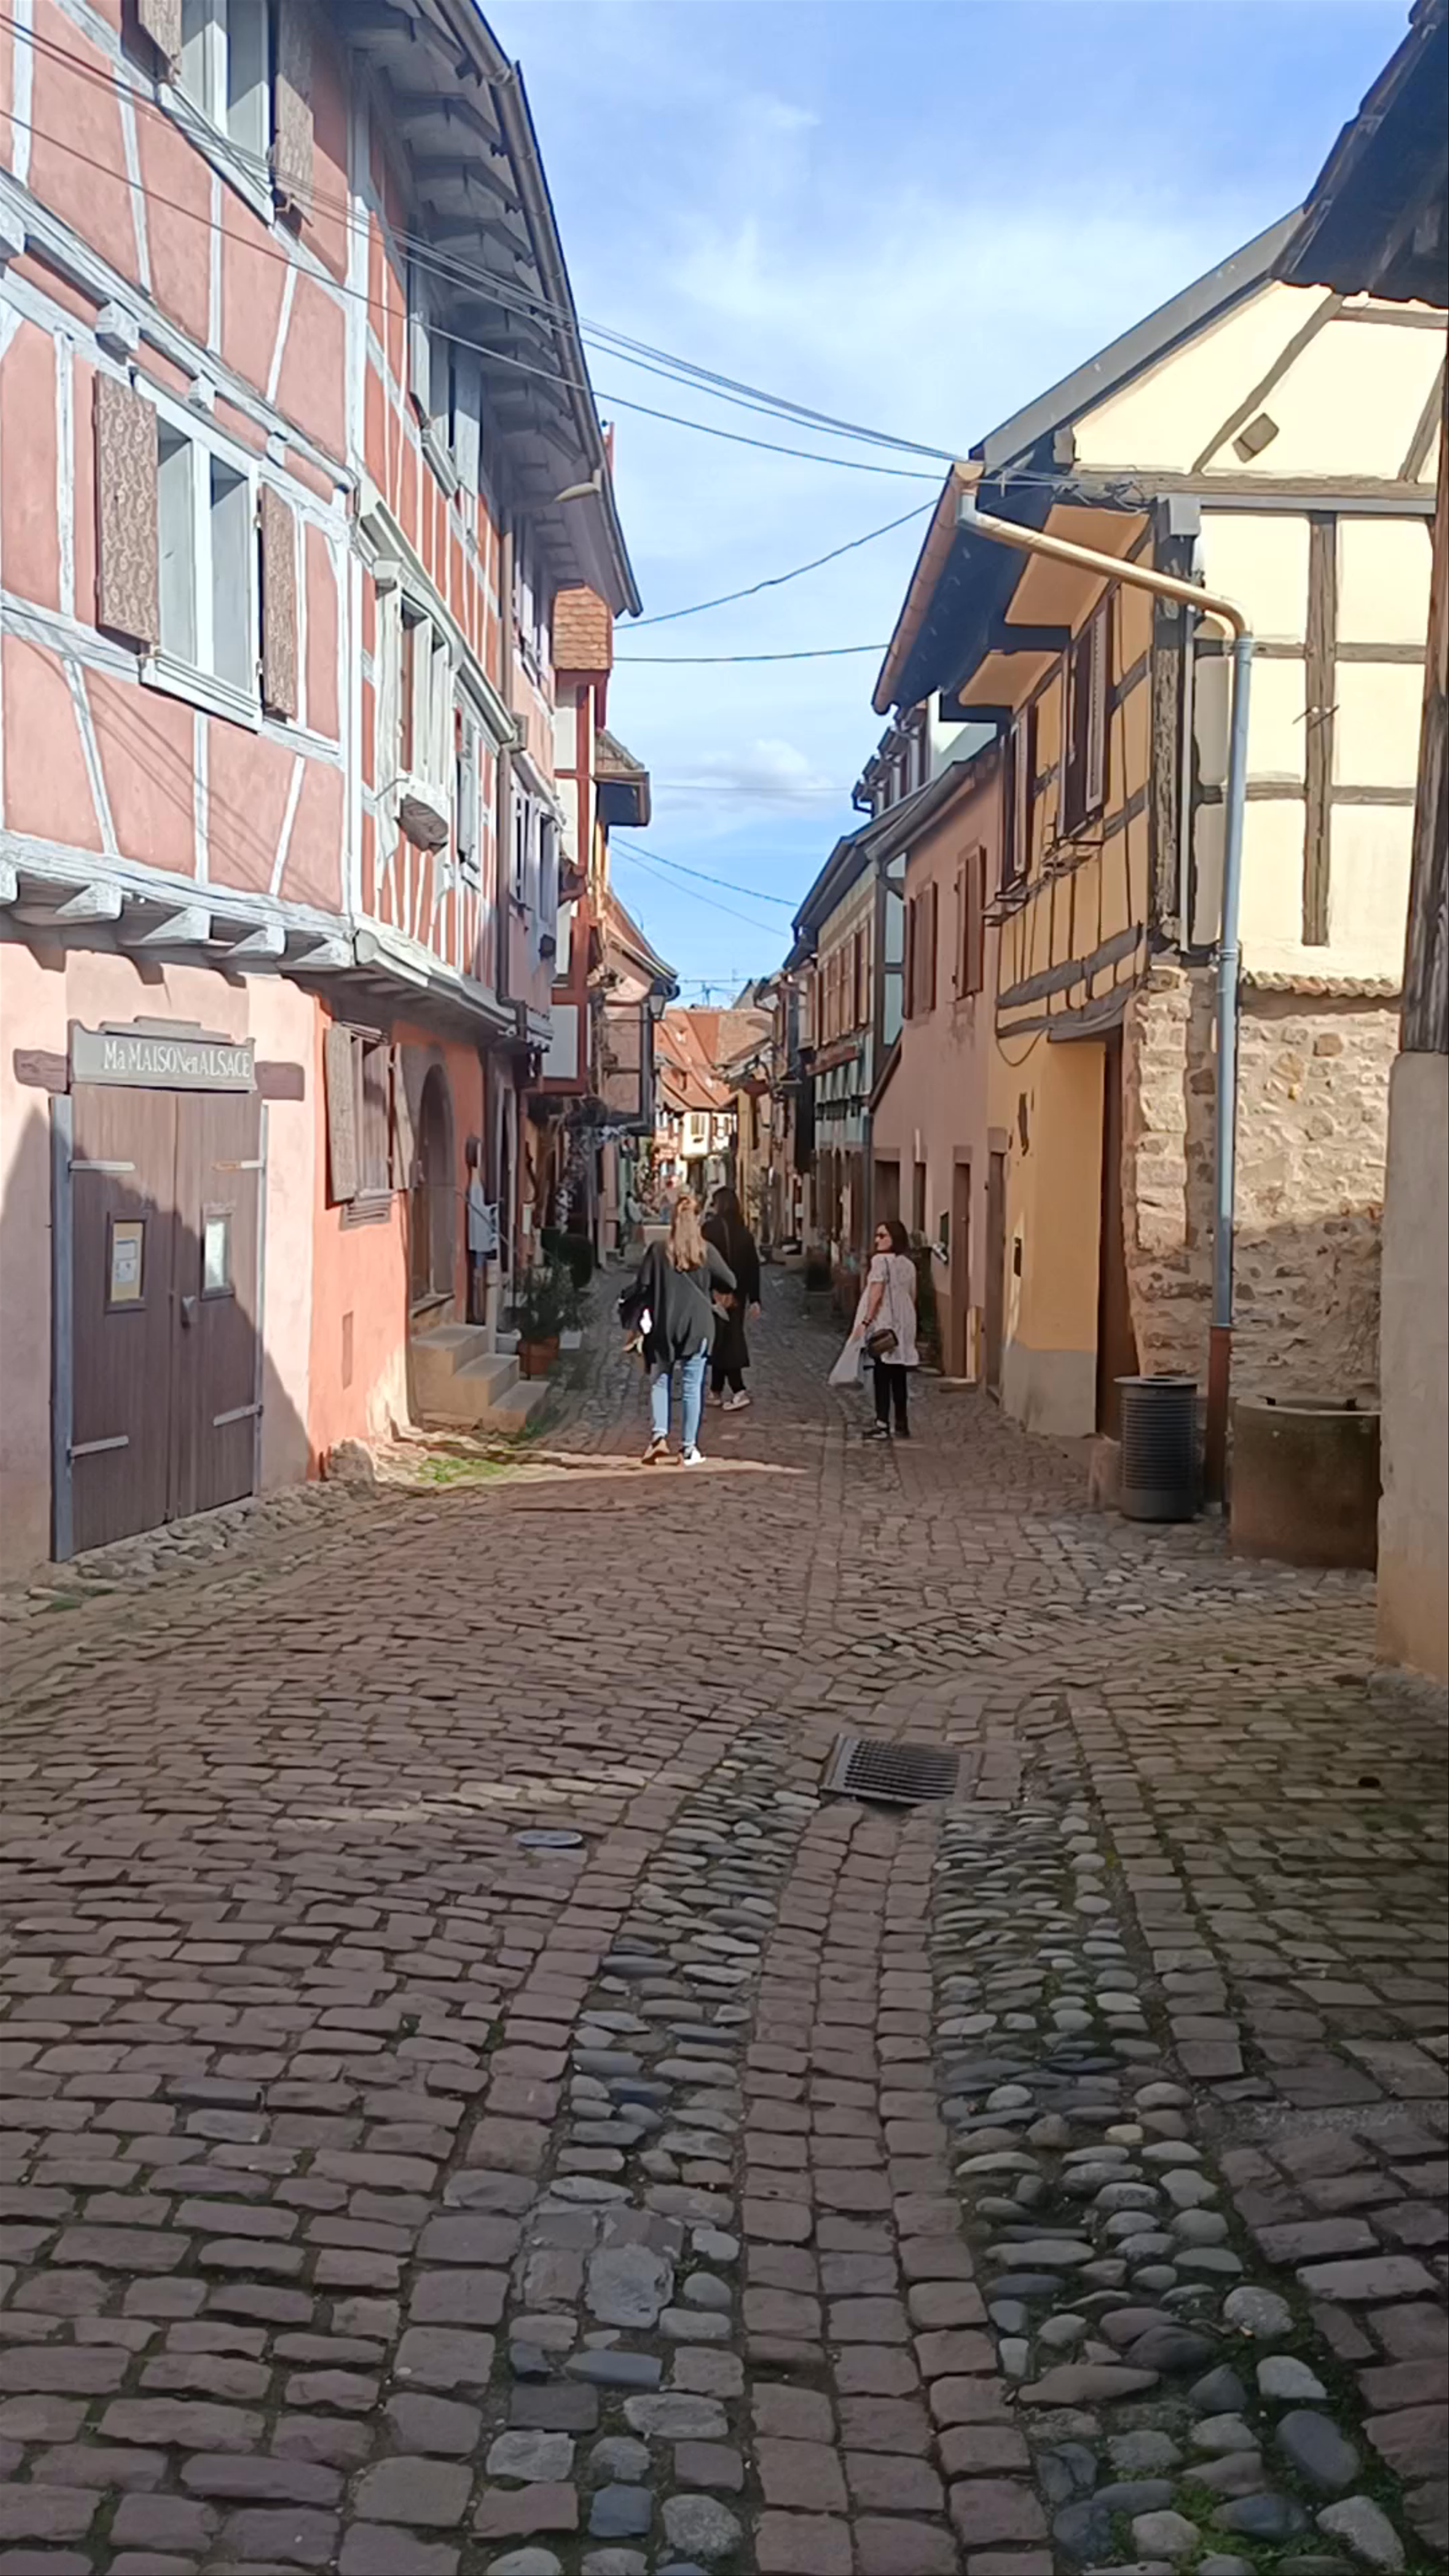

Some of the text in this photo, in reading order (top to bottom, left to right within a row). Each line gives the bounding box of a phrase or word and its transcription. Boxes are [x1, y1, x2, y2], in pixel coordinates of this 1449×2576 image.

[104, 1040, 125, 1069] Ma
[129, 1042, 186, 1073] MAISON
[200, 1049, 250, 1078] ALSACE
